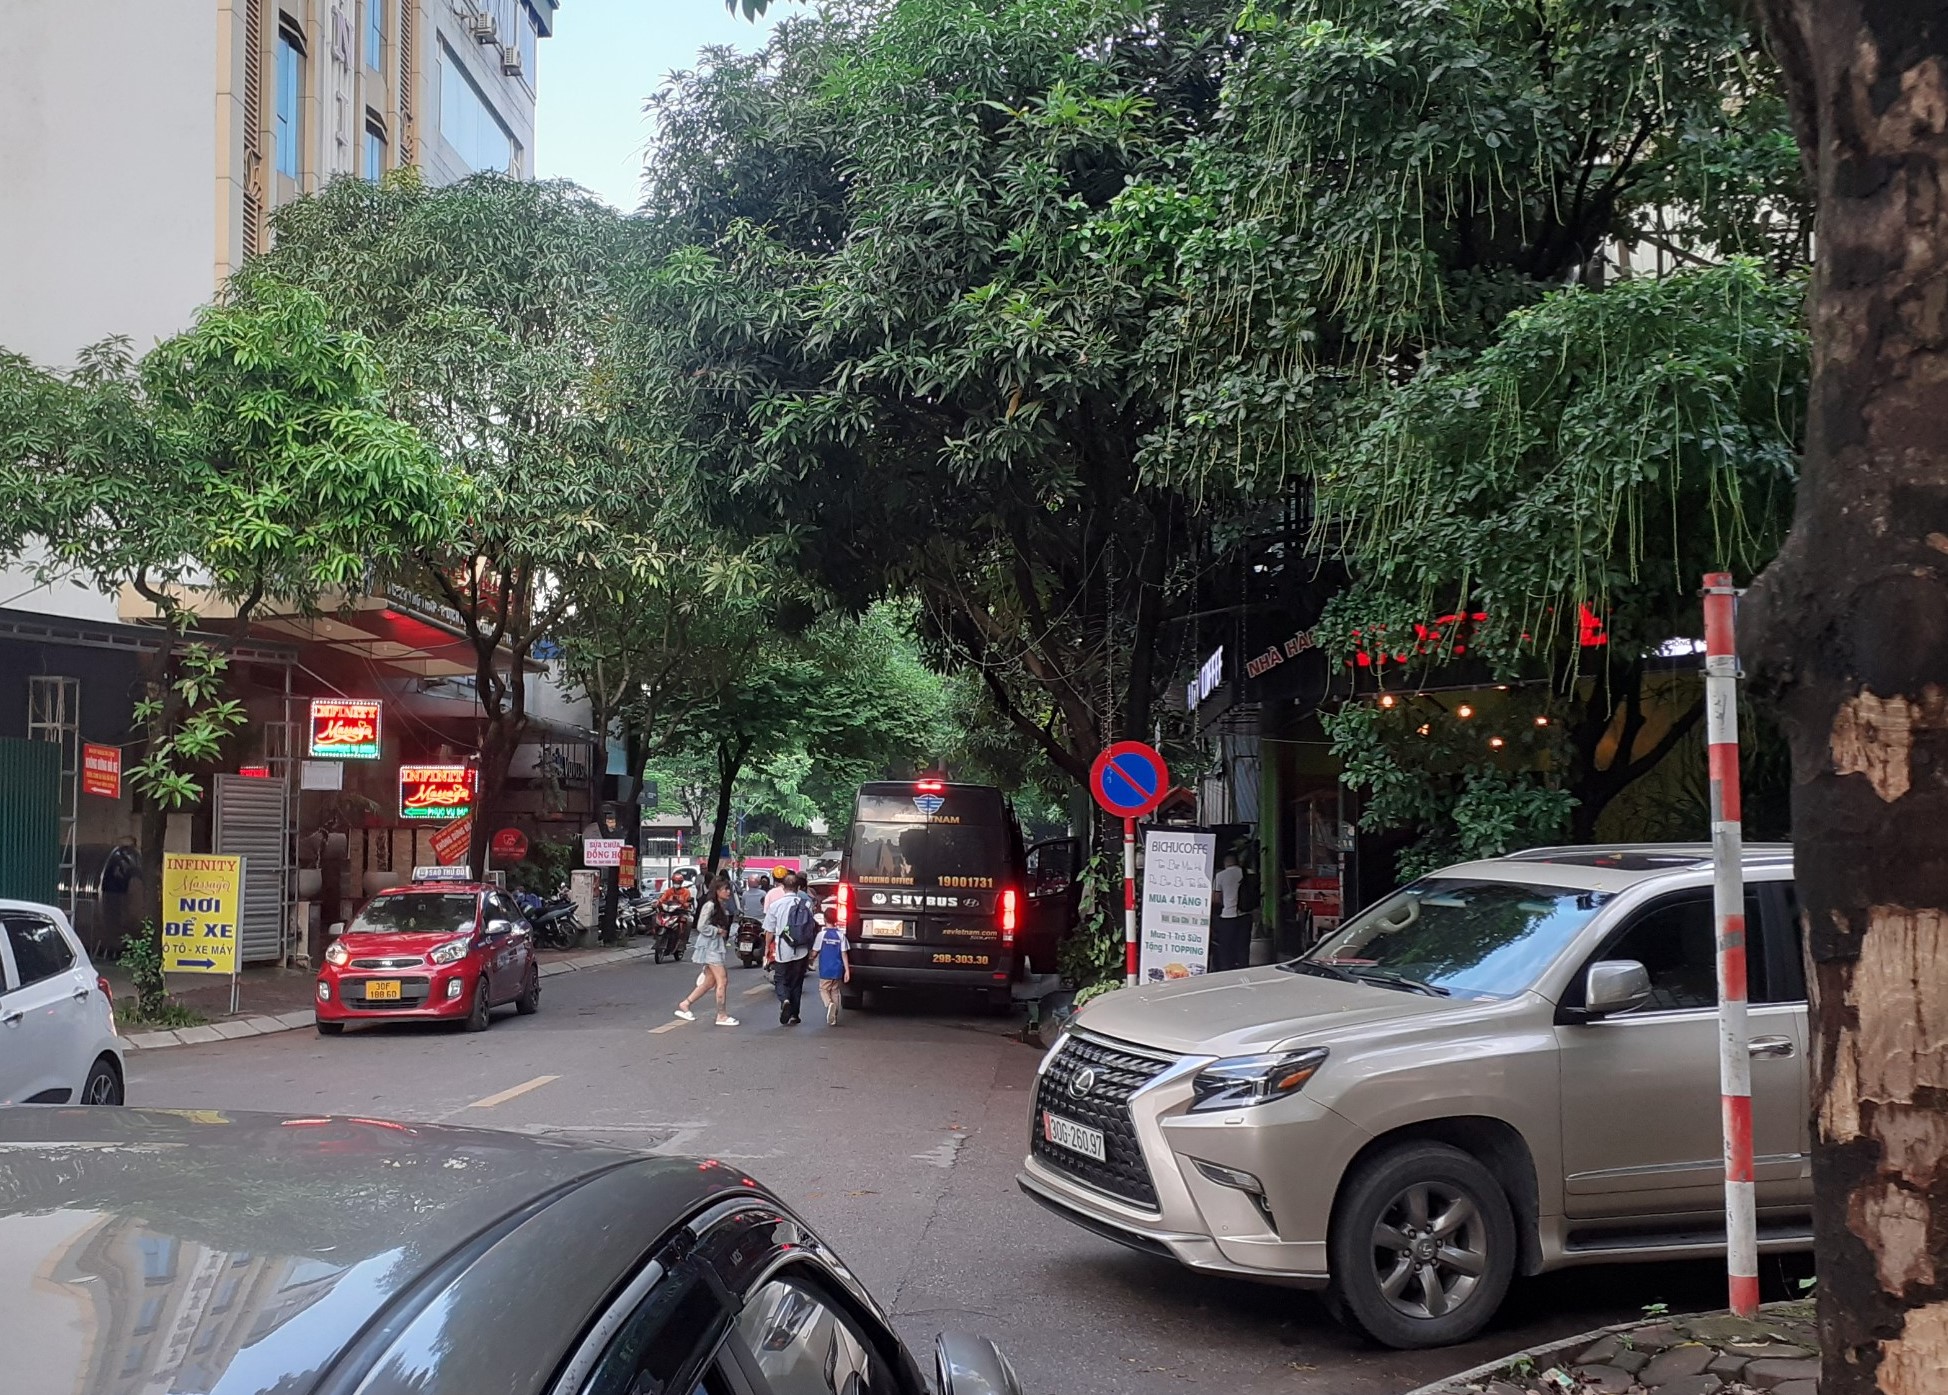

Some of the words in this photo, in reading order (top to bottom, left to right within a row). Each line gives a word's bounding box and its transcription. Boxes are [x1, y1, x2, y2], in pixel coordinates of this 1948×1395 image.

[1247, 645, 1284, 679] NHÀ
[314, 705, 377, 718] INFINITY
[166, 857, 237, 873] INFINITY
[891, 875, 915, 886] OFFICE
[937, 875, 993, 889] 19001731
[180, 897, 220, 914] NƠI
[1148, 894, 1167, 904] MUA
[1169, 895, 1175, 904] 4
[1177, 894, 1201, 908] TẶNG
[165, 915, 197, 938] ĐỂ
[203, 922, 233, 939] XE
[1150, 930, 1166, 939] Mua
[173, 941, 186, 953] TÔ
[195, 944, 208, 955] XE
[211, 942, 233, 955] MÁY
[1145, 942, 1163, 953] Tặng
[1171, 944, 1204, 956] TOPPING
[931, 953, 989, 965] 29B-303.30
[376, 982, 390, 990] 30F
[1051, 1119, 1102, 1157] 30G-260.97
